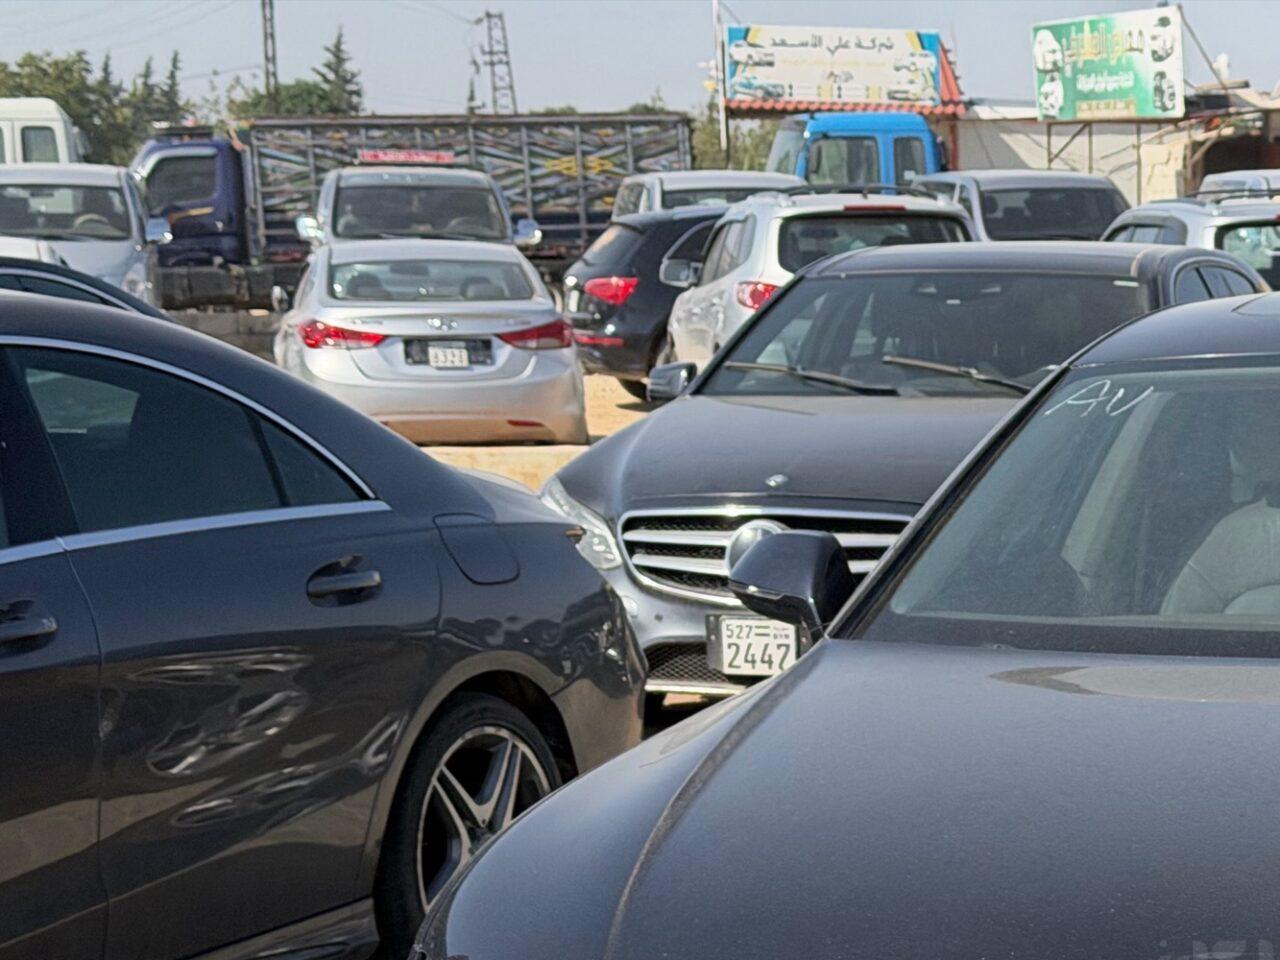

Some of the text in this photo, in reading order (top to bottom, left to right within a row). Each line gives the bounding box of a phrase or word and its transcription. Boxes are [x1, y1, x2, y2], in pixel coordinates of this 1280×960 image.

[826, 36, 850, 56] علي
[854, 35, 894, 53] شركة
[726, 624, 753, 639] 527
[727, 642, 791, 672] 2447
